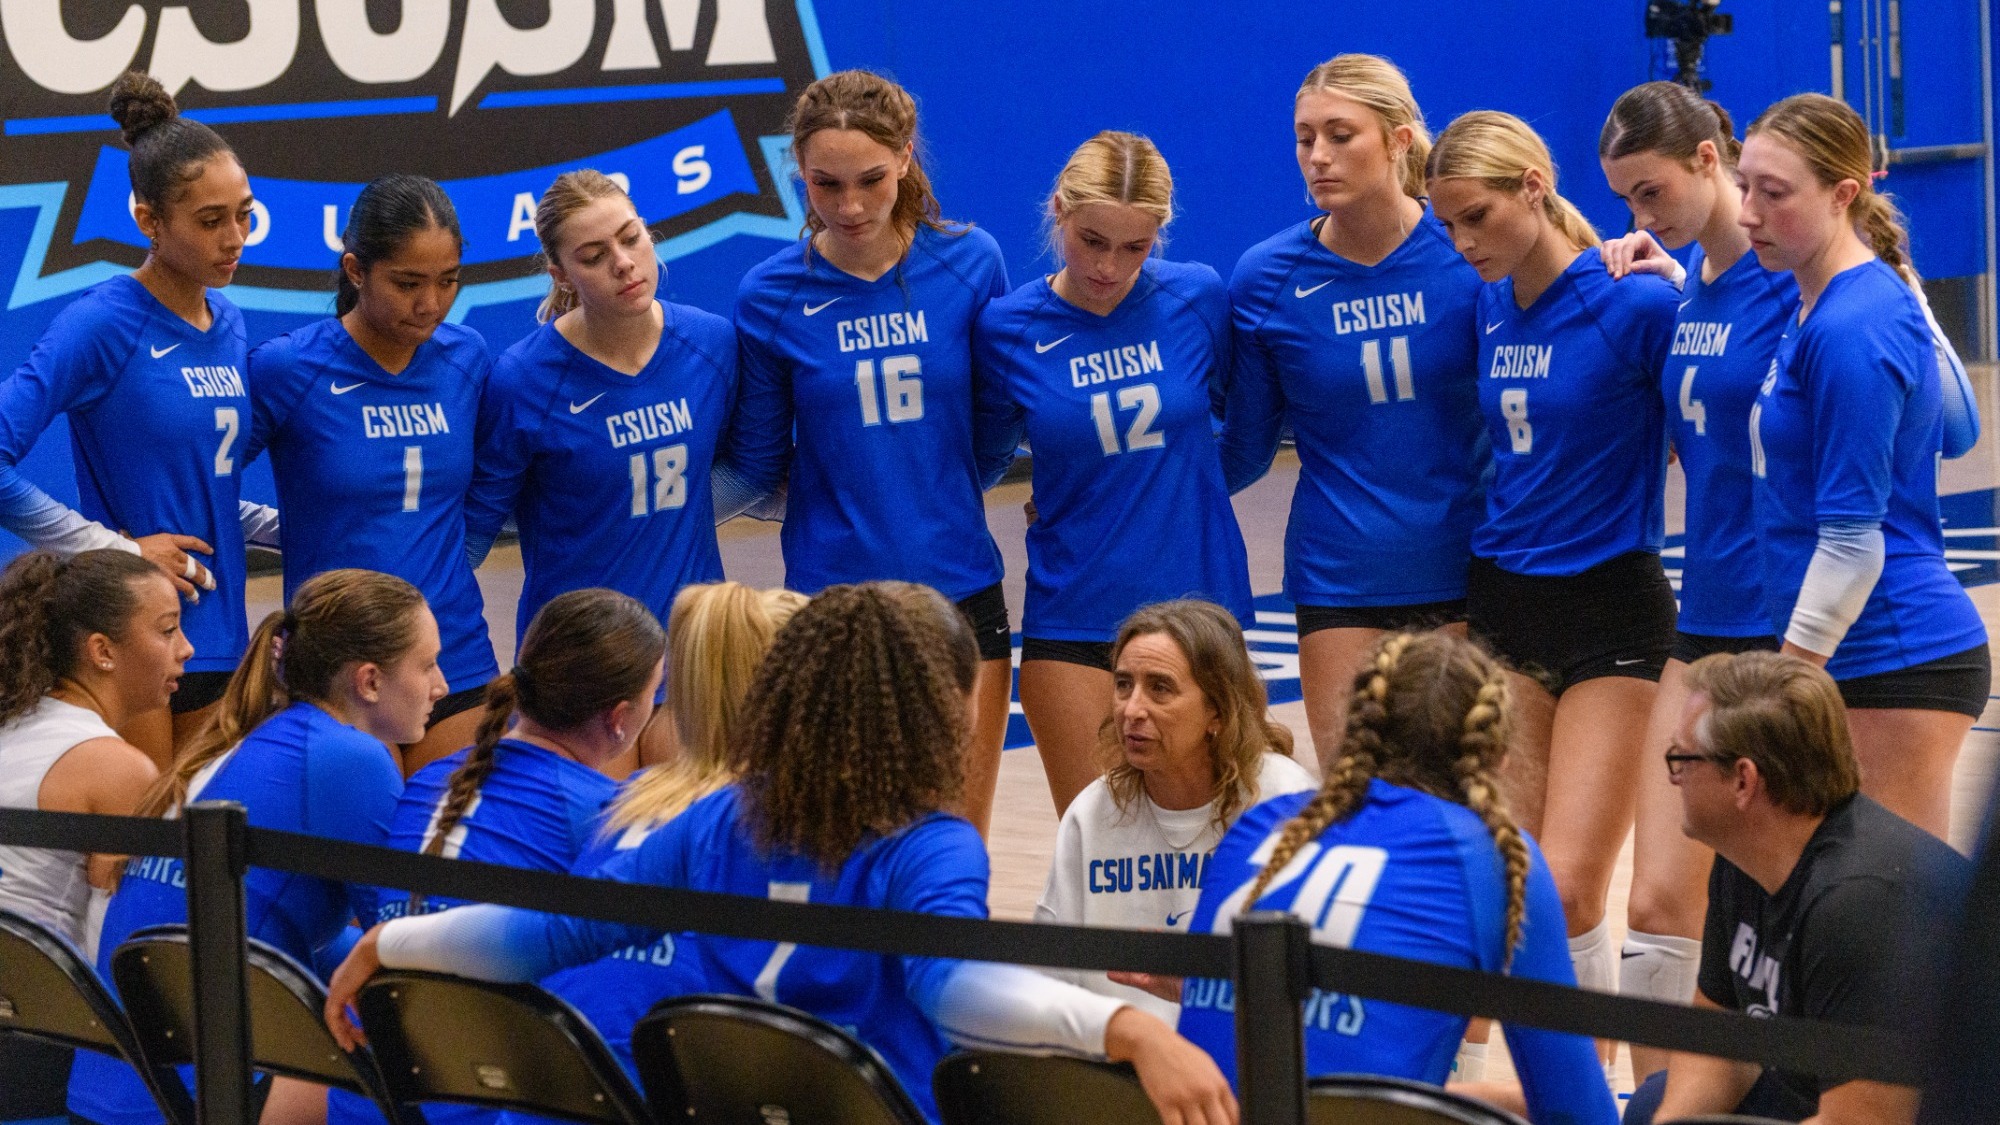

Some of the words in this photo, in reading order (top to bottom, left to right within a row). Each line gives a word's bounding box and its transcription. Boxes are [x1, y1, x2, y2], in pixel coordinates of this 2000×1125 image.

[836, 309, 929, 352] CSUSM
[1332, 291, 1426, 335] CSUSM
[1069, 340, 1164, 389] CSUSM
[1490, 345, 1553, 378] CSUSM
[1671, 322, 1733, 356] CSUSM
[181, 366, 246, 398] CSUSM
[854, 354, 925, 427] 16
[1360, 335, 1416, 405] 11
[362, 403, 450, 439] CSUSM
[606, 398, 693, 449] CSUSM
[1090, 382, 1166, 457] 12
[1501, 388, 1533, 455] 8
[1679, 365, 1707, 436] 4
[214, 407, 239, 477] 2
[402, 445, 423, 513] 1
[629, 442, 689, 519] 18
[1089, 857, 1133, 894] CSU
